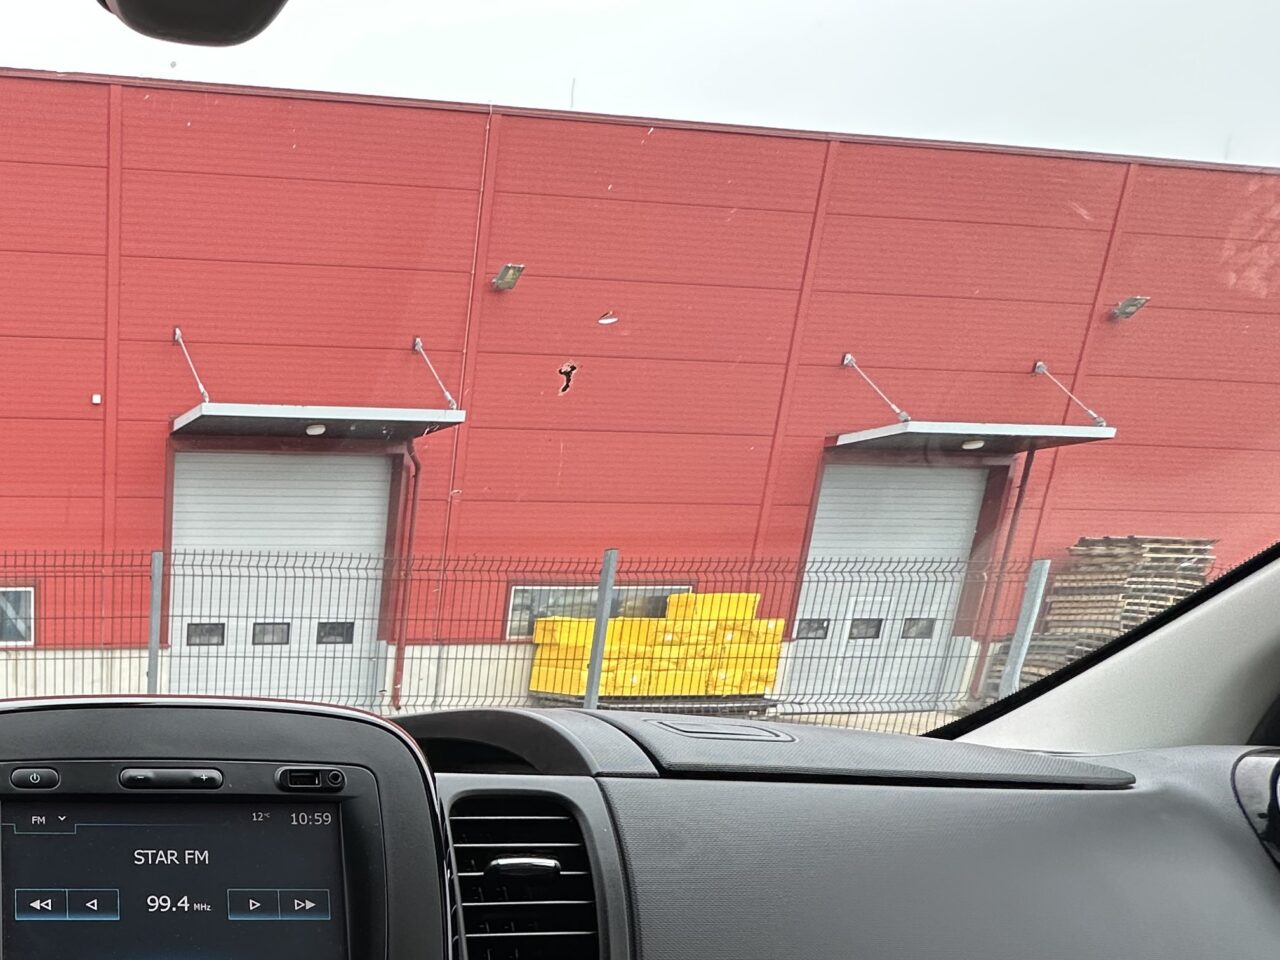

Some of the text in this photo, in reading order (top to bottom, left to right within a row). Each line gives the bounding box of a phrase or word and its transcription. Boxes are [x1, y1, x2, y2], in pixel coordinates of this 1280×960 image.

[31, 815, 46, 825] FM
[290, 812, 332, 826] 10:59
[134, 849, 209, 866] STAR FM
[146, 895, 212, 913] 99.4 MHz
